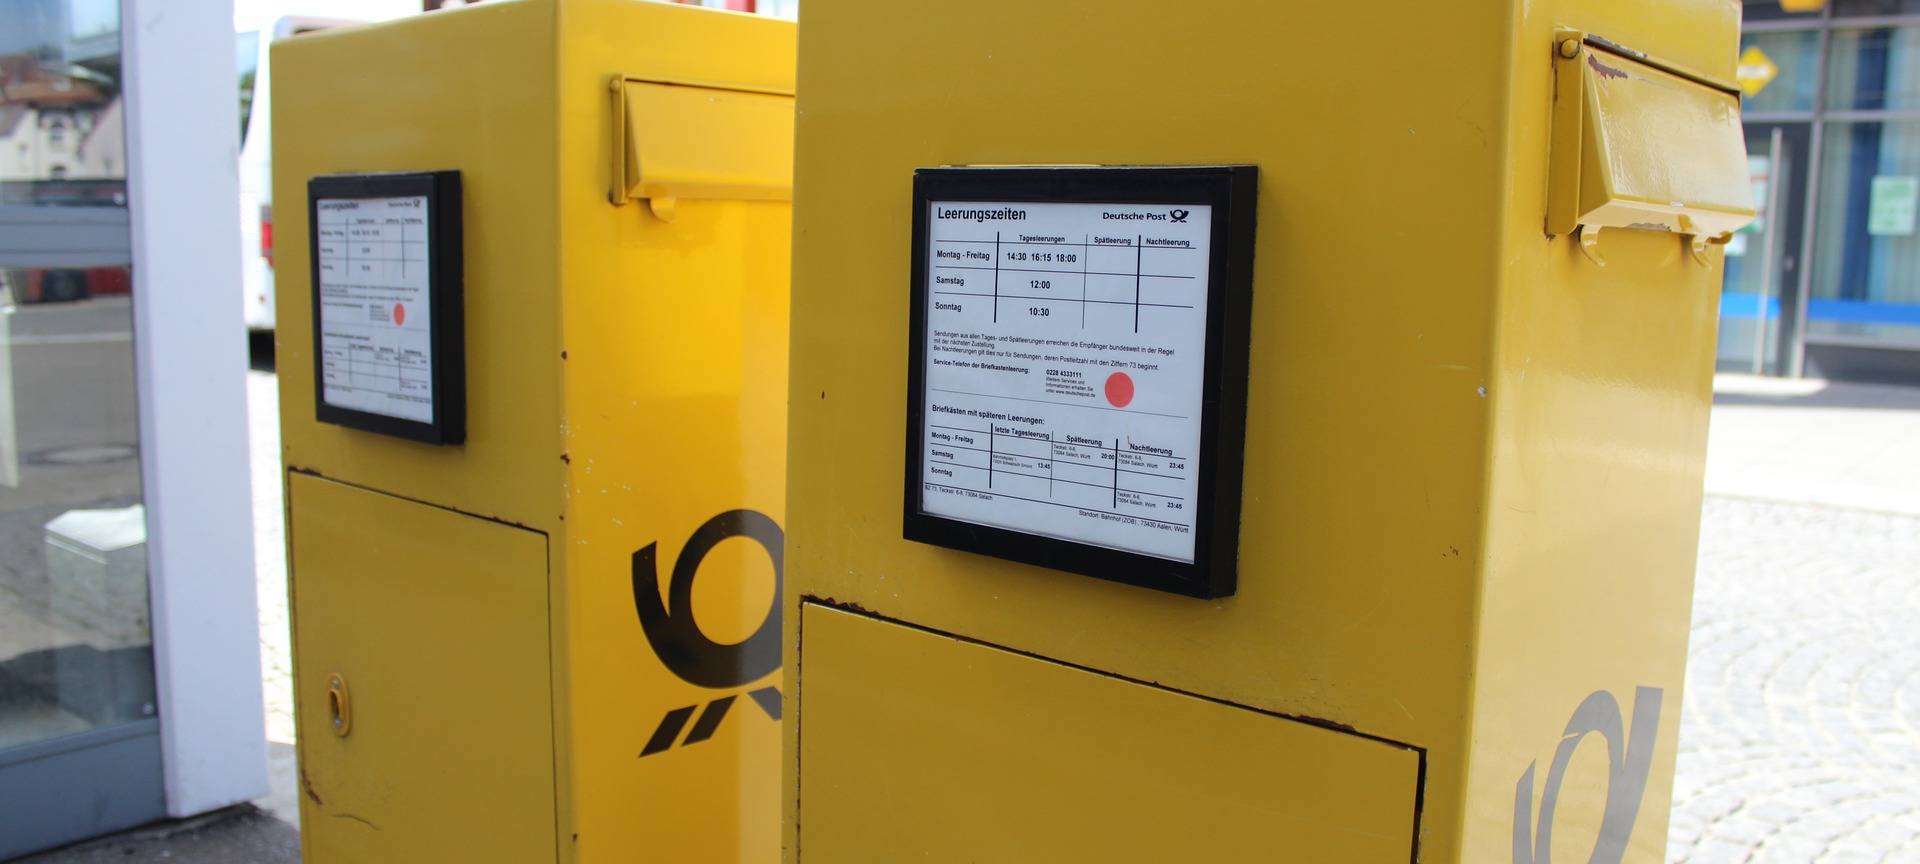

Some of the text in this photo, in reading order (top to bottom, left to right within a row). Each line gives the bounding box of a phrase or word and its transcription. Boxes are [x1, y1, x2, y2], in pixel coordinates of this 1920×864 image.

[938, 207, 1027, 223] Leerungszeiten
[1102, 212, 1167, 221] Deutsche Post
[1019, 234, 1066, 243] Tagesleerungen
[1094, 236, 1132, 246] Spätleerung
[1146, 238, 1190, 248] Nachtleerung
[936, 250, 961, 260] Montag
[966, 251, 990, 261] Freitag
[1007, 252, 1077, 263] 14:30 16:15 18:00
[936, 276, 965, 286] Samstag
[1030, 280, 1051, 289] 12:00
[935, 302, 962, 312] Sonntag
[1029, 307, 1050, 317] 10:30
[934, 330, 960, 339] Sendungen
[981, 334, 998, 342] Tages-
[1009, 335, 1045, 345] Spätleerungen
[1045, 339, 1070, 347] erreichen
[1080, 341, 1108, 351] Empfänger
[1109, 343, 1140, 353] bundesweit
[1157, 348, 1175, 357] Regel
[934, 358, 970, 367] Service-Telefon
[980, 362, 1030, 375] Briefkastenleerung:
[1060, 355, 1089, 364] Postleitzahl
[1110, 360, 1128, 368] Ziffern
[1129, 361, 1137, 369] 73
[932, 404, 1045, 426] Briefkästen mit späteren Leerungen:
[931, 431, 951, 441] Montag
[955, 434, 974, 445] Freitag
[994, 426, 1050, 440] letzte Tagesleerung
[1066, 434, 1102, 447] Spätleerung
[931, 449, 954, 460] Samstag
[1129, 443, 1173, 456] Nachtleerung
[1101, 452, 1115, 460] 20:00
[1037, 462, 1051, 470] 13:45
[1169, 462, 1185, 470] 23:45
[930, 467, 953, 477] Sonntag
[1167, 501, 1183, 510] 23:45
[1101, 512, 1121, 522] Bahnhof
[1122, 517, 1137, 525] (ZOB)
[1141, 520, 1157, 529] 73430
